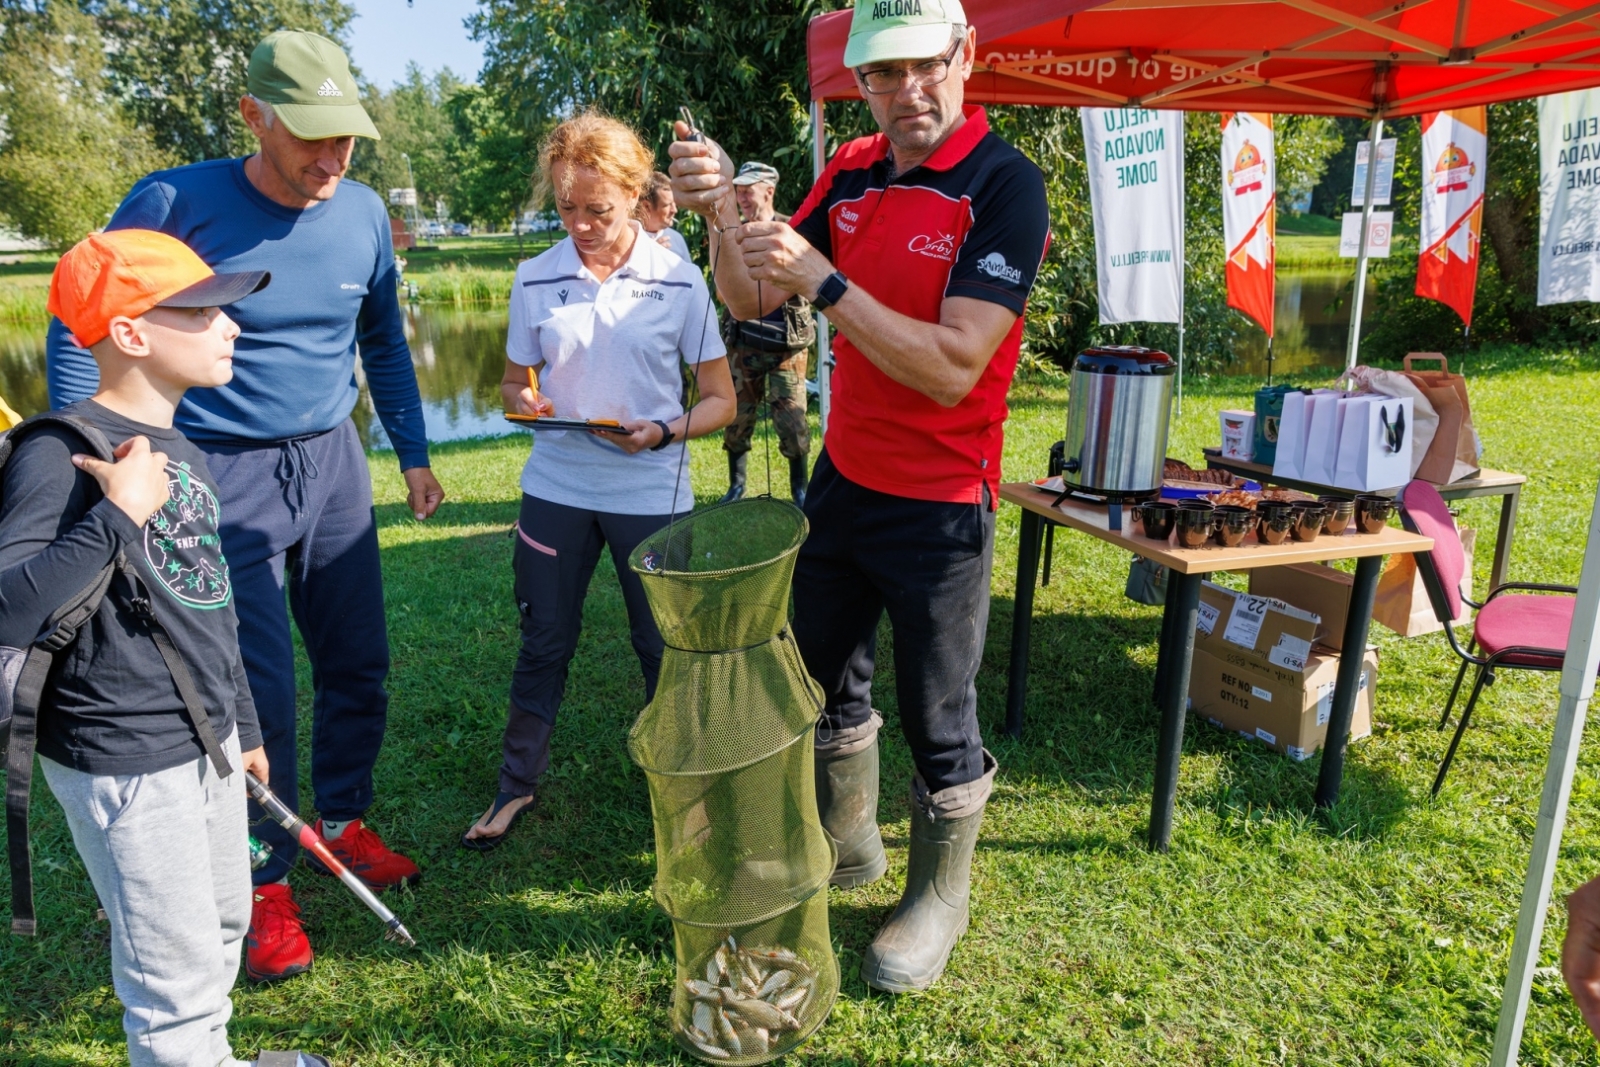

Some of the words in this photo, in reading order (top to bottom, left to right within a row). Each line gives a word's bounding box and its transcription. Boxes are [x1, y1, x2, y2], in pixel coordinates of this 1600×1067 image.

[873, 0, 922, 20] AGLONA
[317, 89, 344, 98] adidas
[840, 206, 859, 222] Sam
[908, 234, 953, 256] Corby
[976, 258, 1022, 281] SAMURAI
[1247, 598, 1267, 614] 22
[1221, 673, 1237, 687] REF
[1220, 689, 1249, 710] QTY:12
